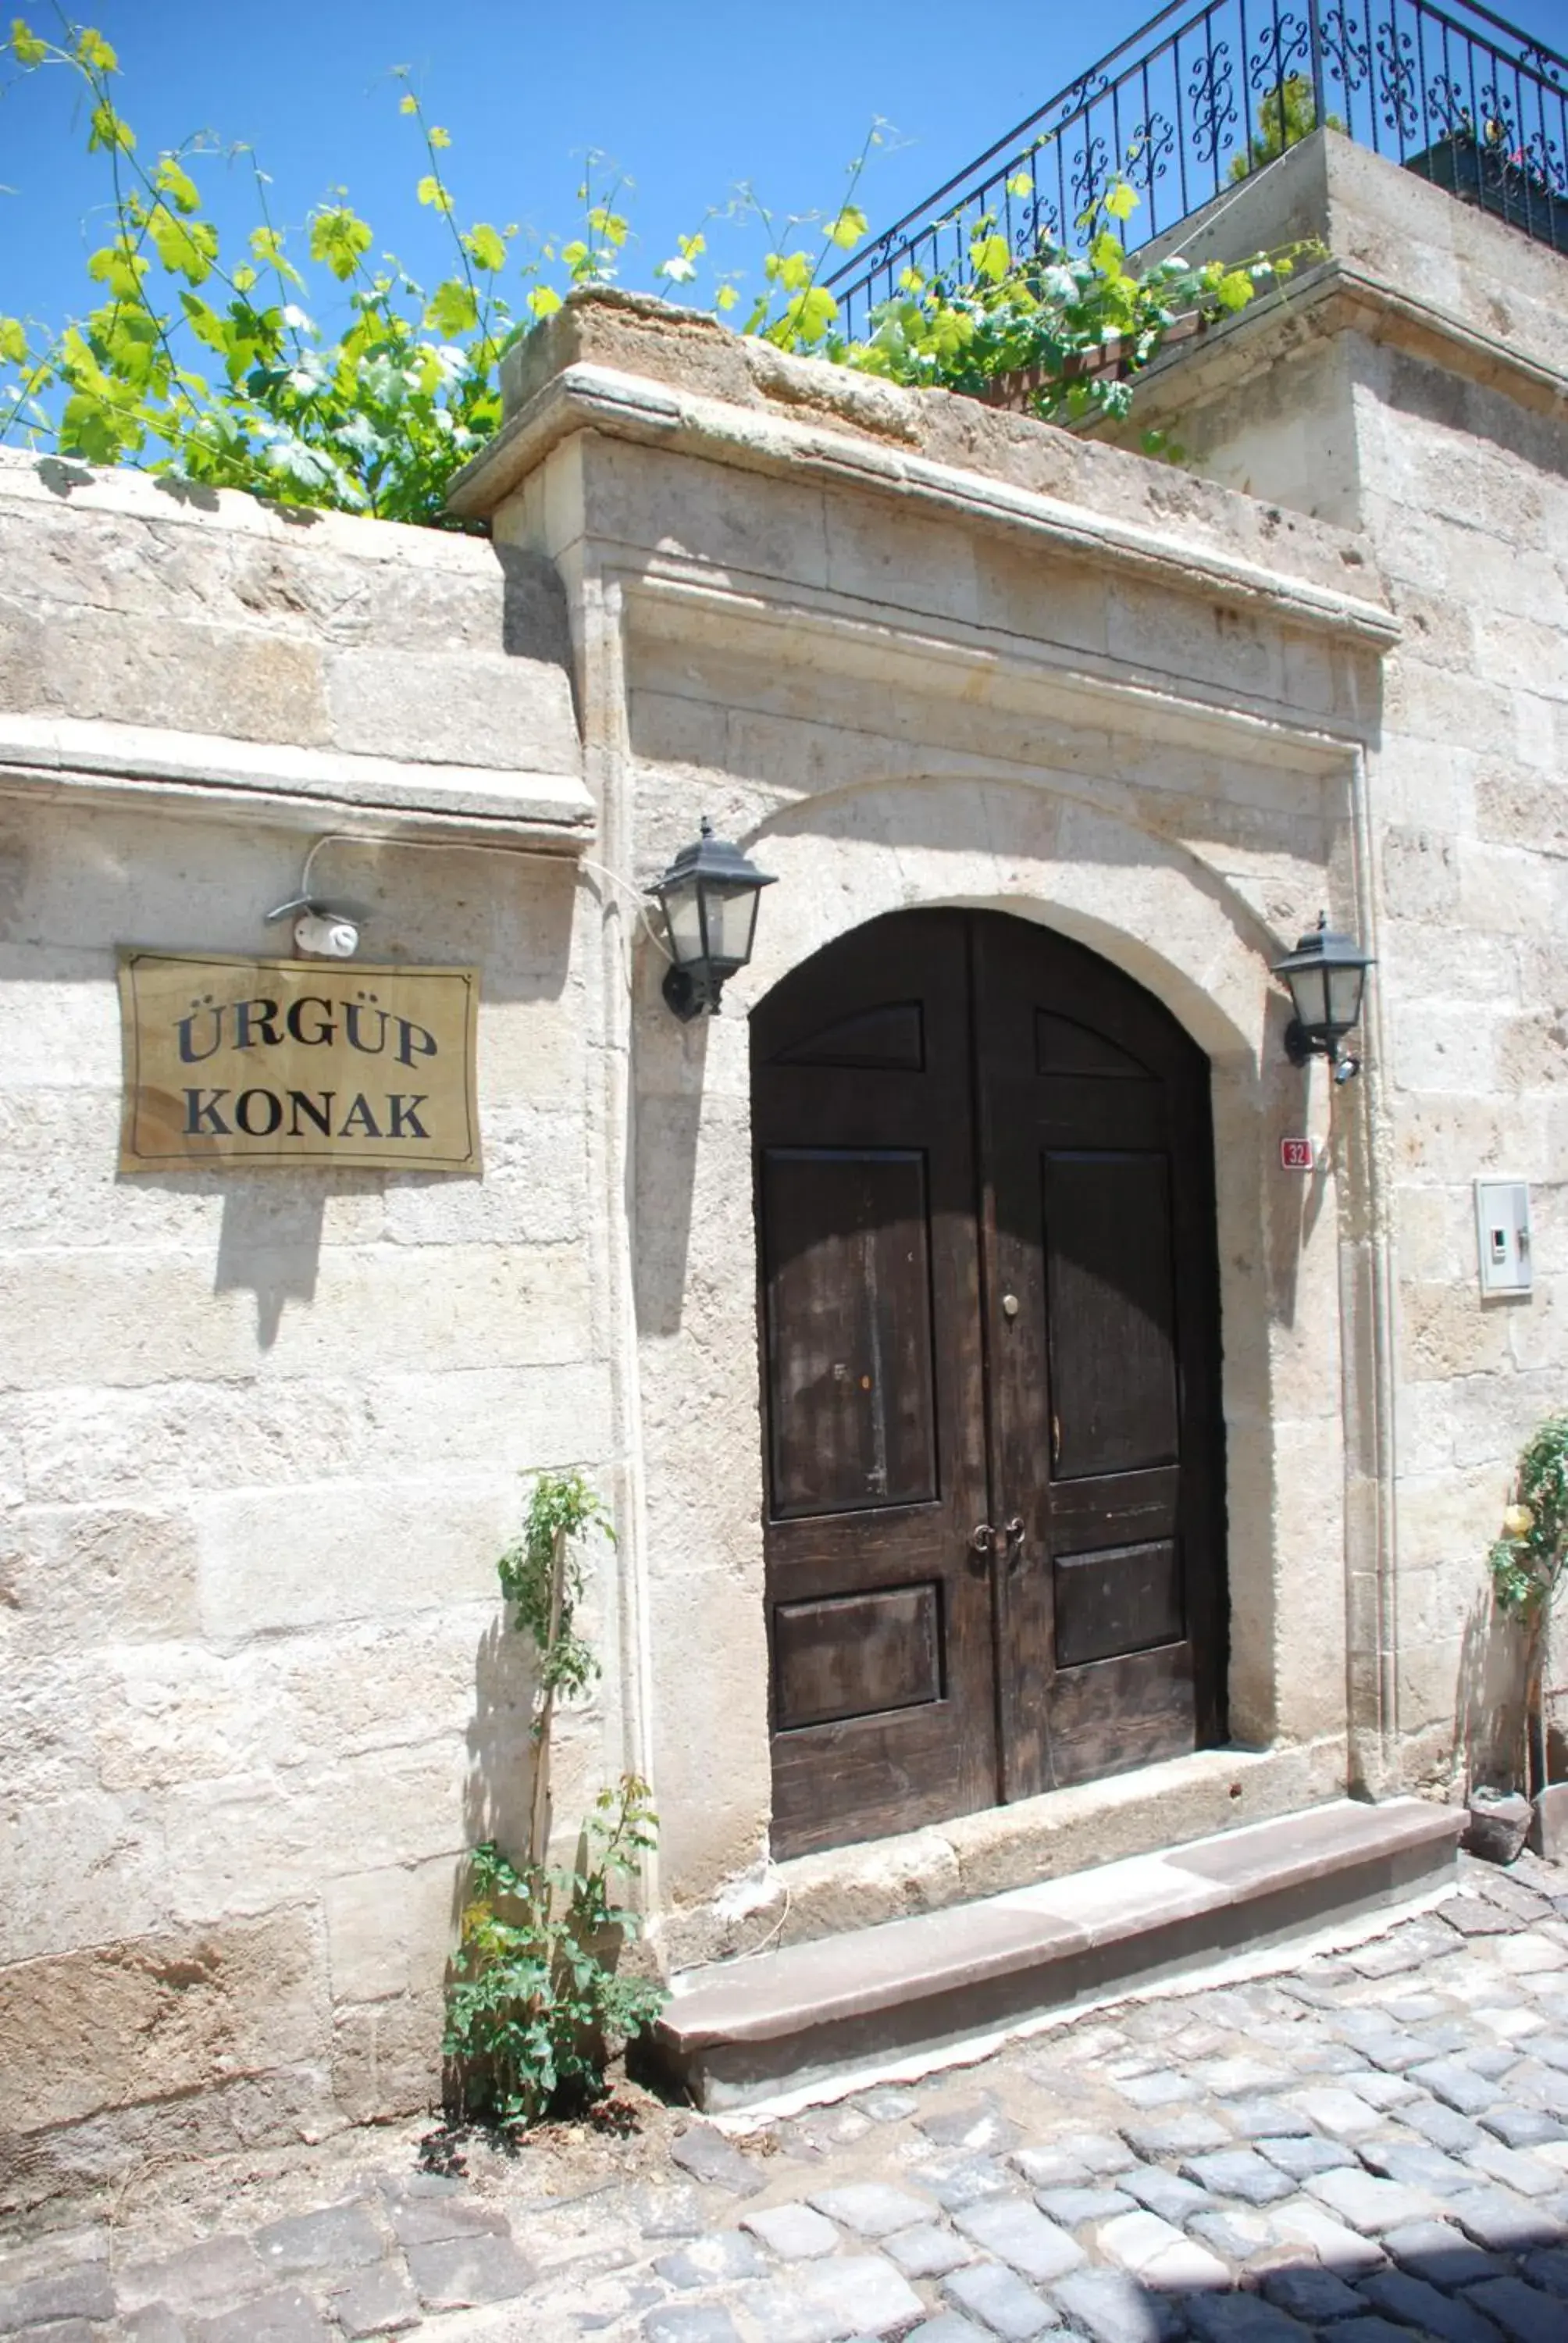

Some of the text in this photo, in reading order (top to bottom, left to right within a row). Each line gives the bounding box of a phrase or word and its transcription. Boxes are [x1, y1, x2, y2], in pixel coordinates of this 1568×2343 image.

[173, 990, 438, 1069] ÜRGÜP
[182, 1088, 431, 1138] KONAK
[1289, 1144, 1305, 1164] 32
